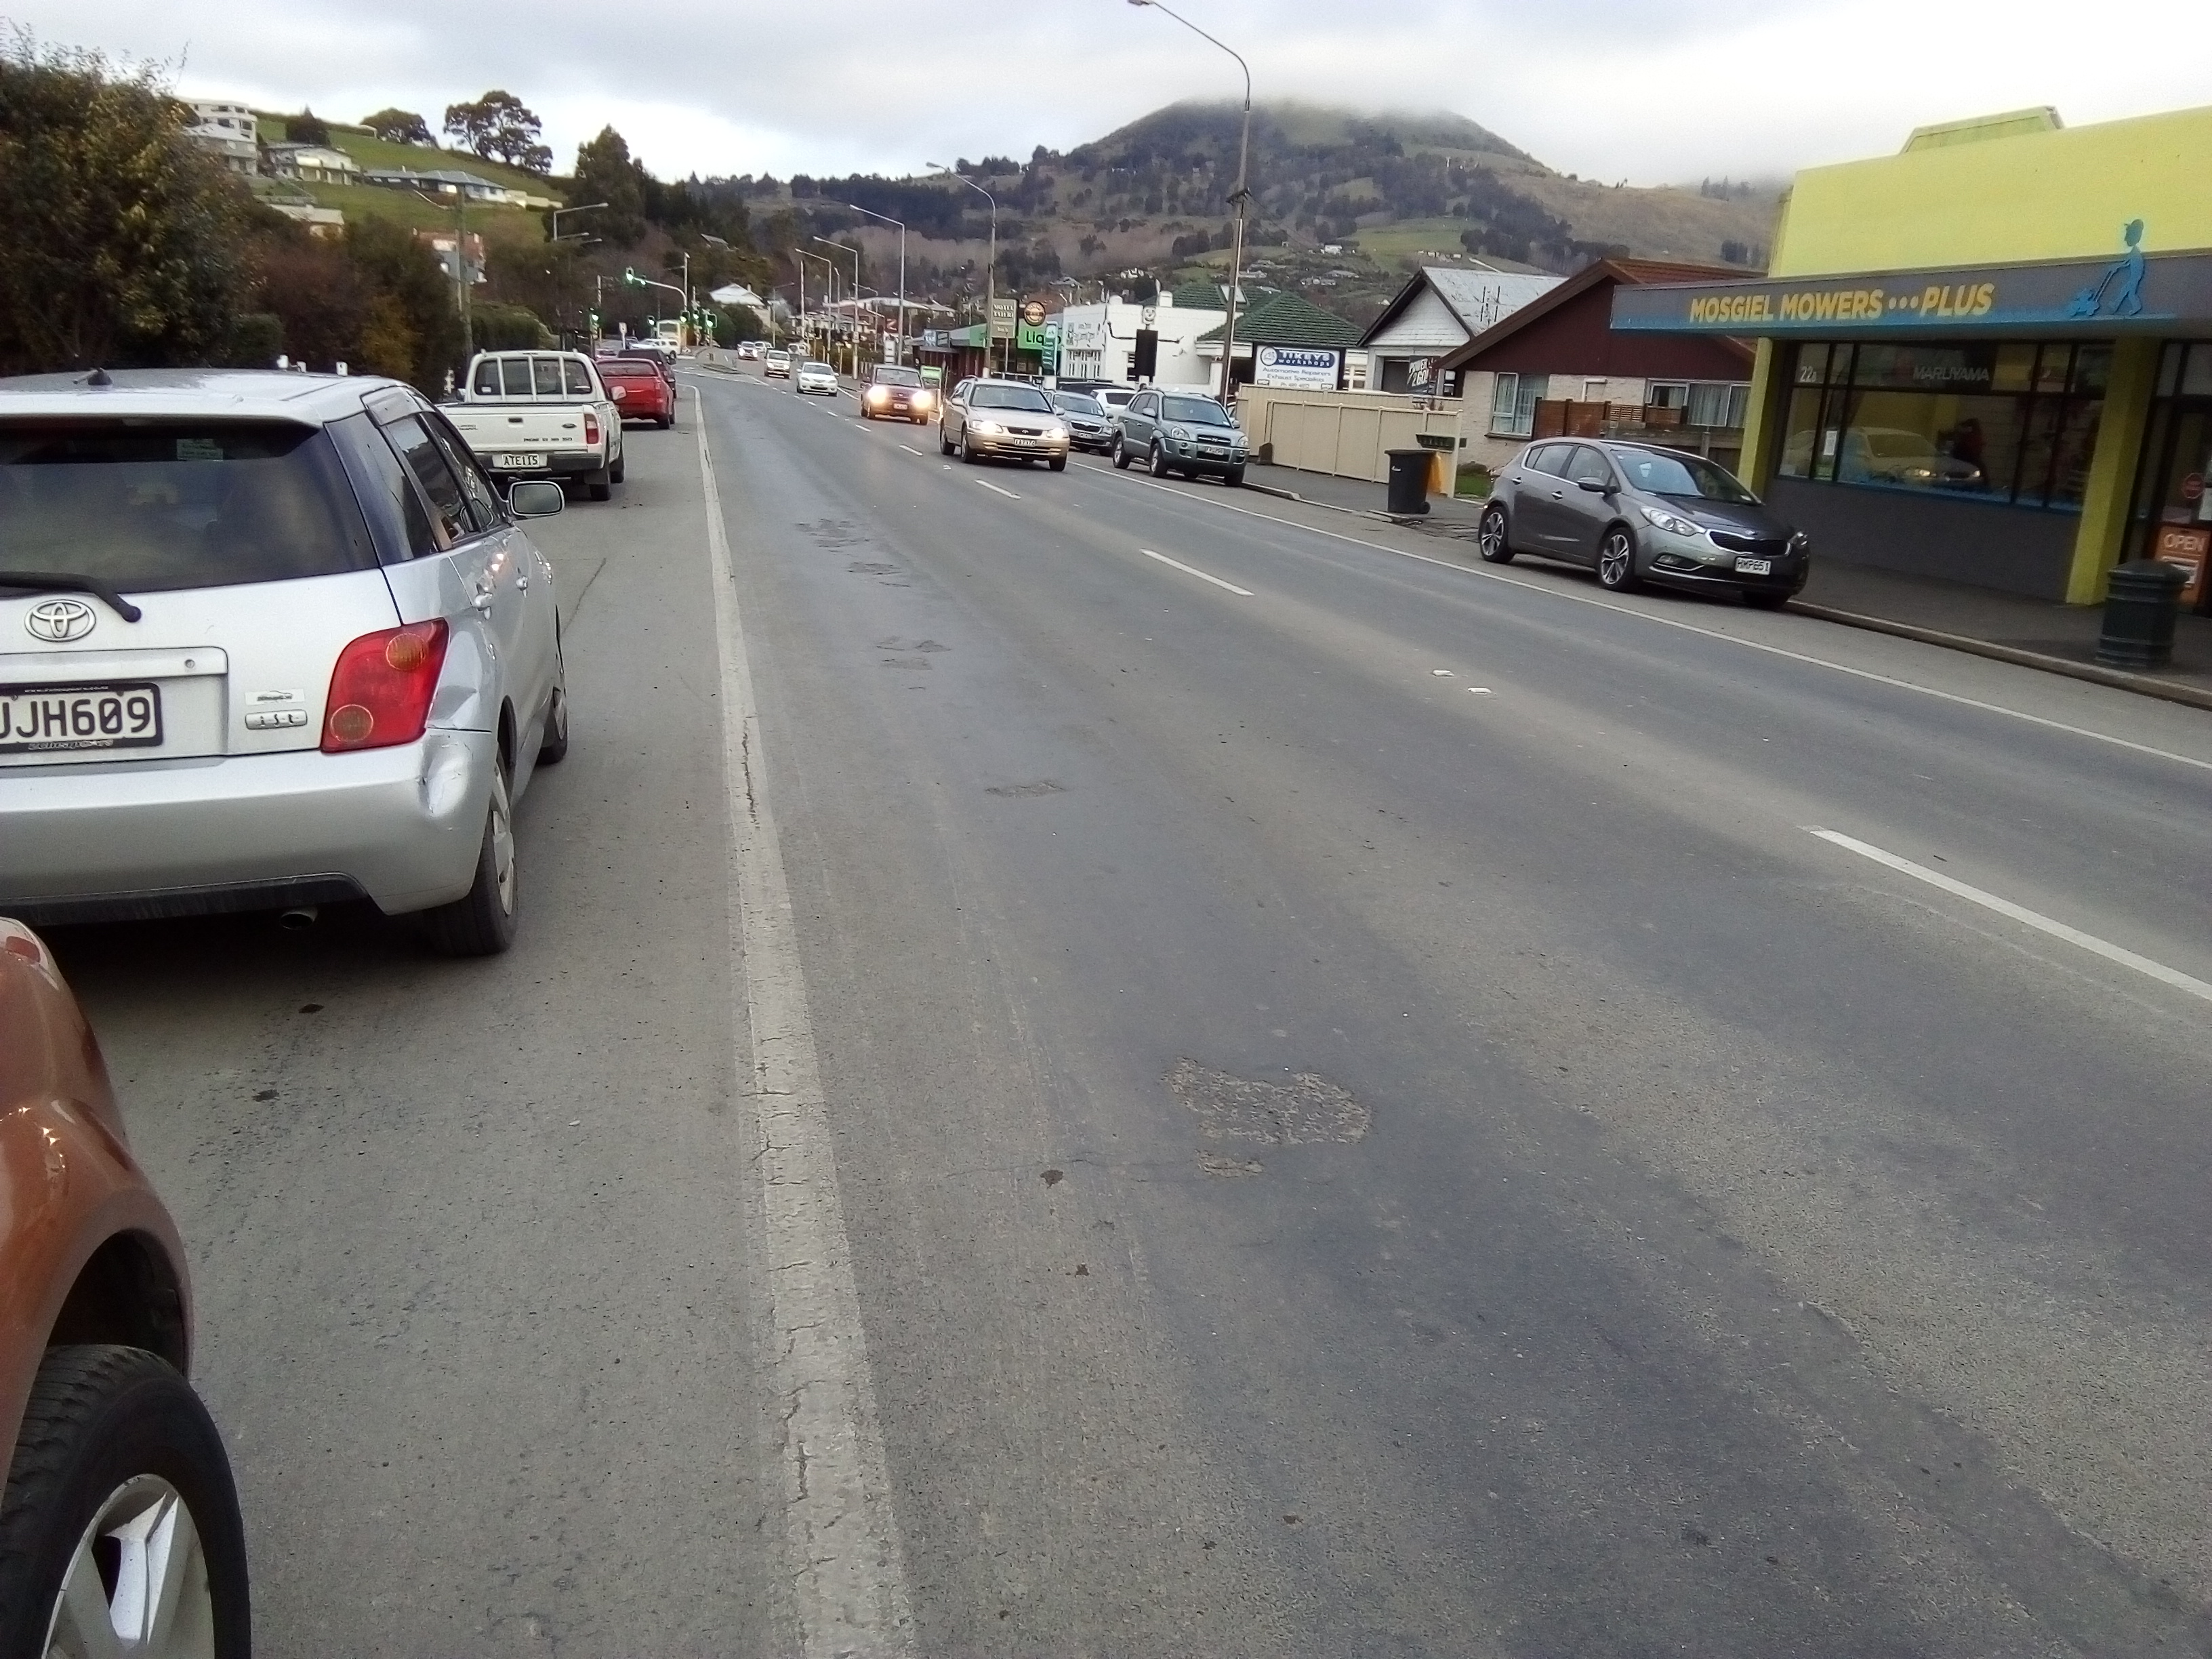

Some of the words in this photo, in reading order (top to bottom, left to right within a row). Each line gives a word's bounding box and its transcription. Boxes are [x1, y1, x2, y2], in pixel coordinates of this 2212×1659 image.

[1689, 294, 1774, 323] MOSGIEL
[1278, 359, 1330, 367] workshops
[1912, 366, 1990, 382] MARUYAMA
[504, 455, 538, 466] ATE115
[2163, 533, 2206, 552] OPEN
